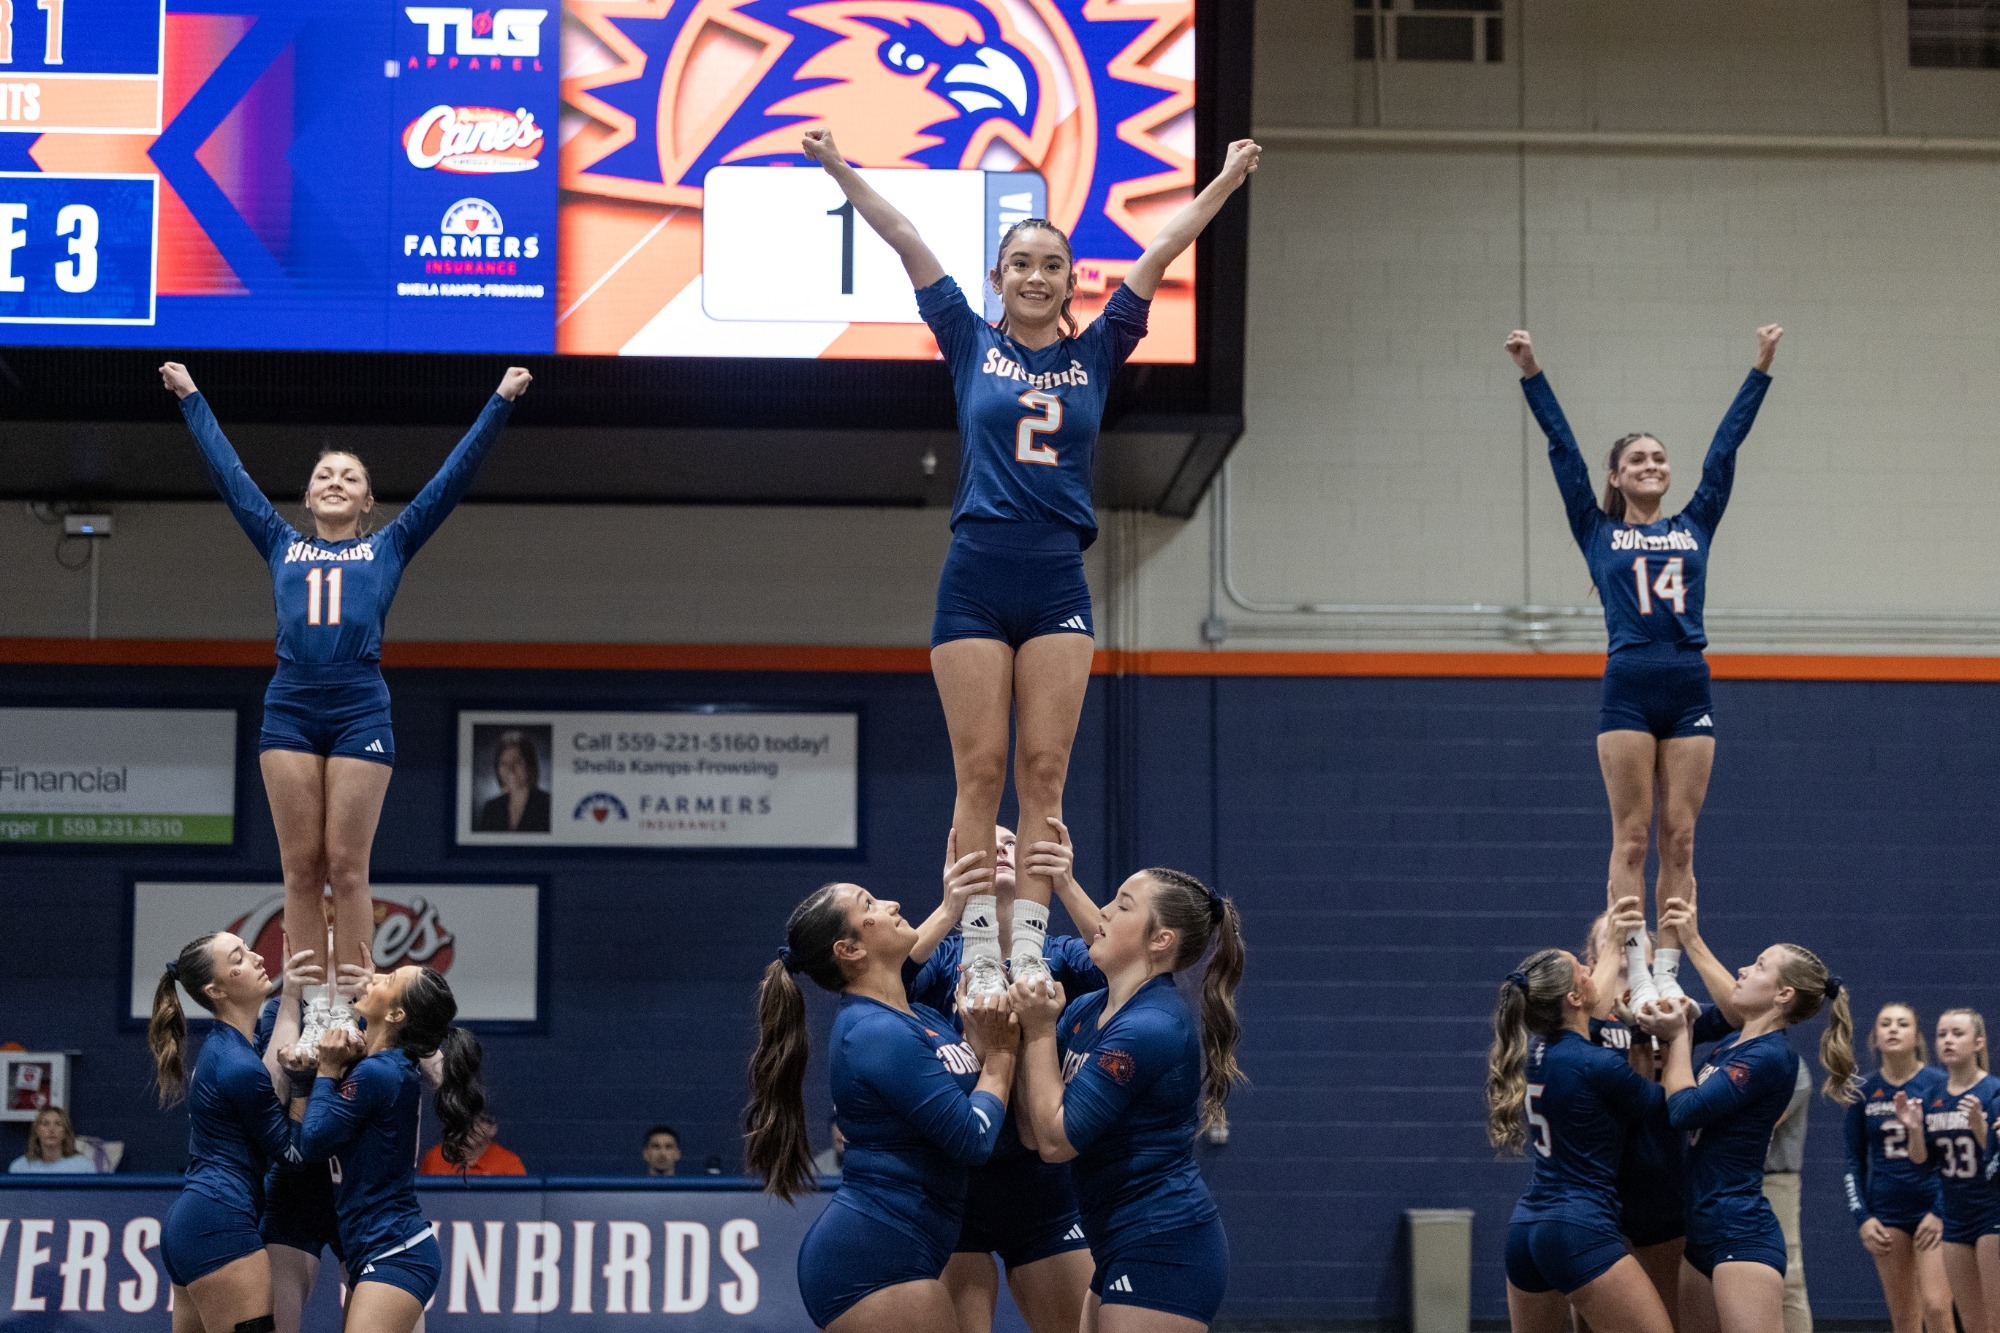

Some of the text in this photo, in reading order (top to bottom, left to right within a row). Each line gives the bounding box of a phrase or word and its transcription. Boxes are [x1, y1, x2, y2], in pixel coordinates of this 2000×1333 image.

[37, 0, 64, 64] 1
[407, 56, 543, 72] APPAREL
[407, 104, 543, 169] Cane's
[55, 203, 99, 293] 3
[404, 234, 539, 258] FARMERS
[425, 260, 517, 276] INSURANCE
[826, 197, 855, 295] 1
[1015, 389, 1063, 467] 2
[305, 567, 342, 626] 11
[1631, 556, 1688, 614] 14
[571, 732, 830, 757] Call 559-221-5160 today!
[0, 766, 127, 793] Financial
[640, 795, 772, 815] FARMERS
[640, 819, 728, 832] INSURANCE
[1524, 1083, 1552, 1159] 5
[1935, 1135, 1978, 1179] 33
